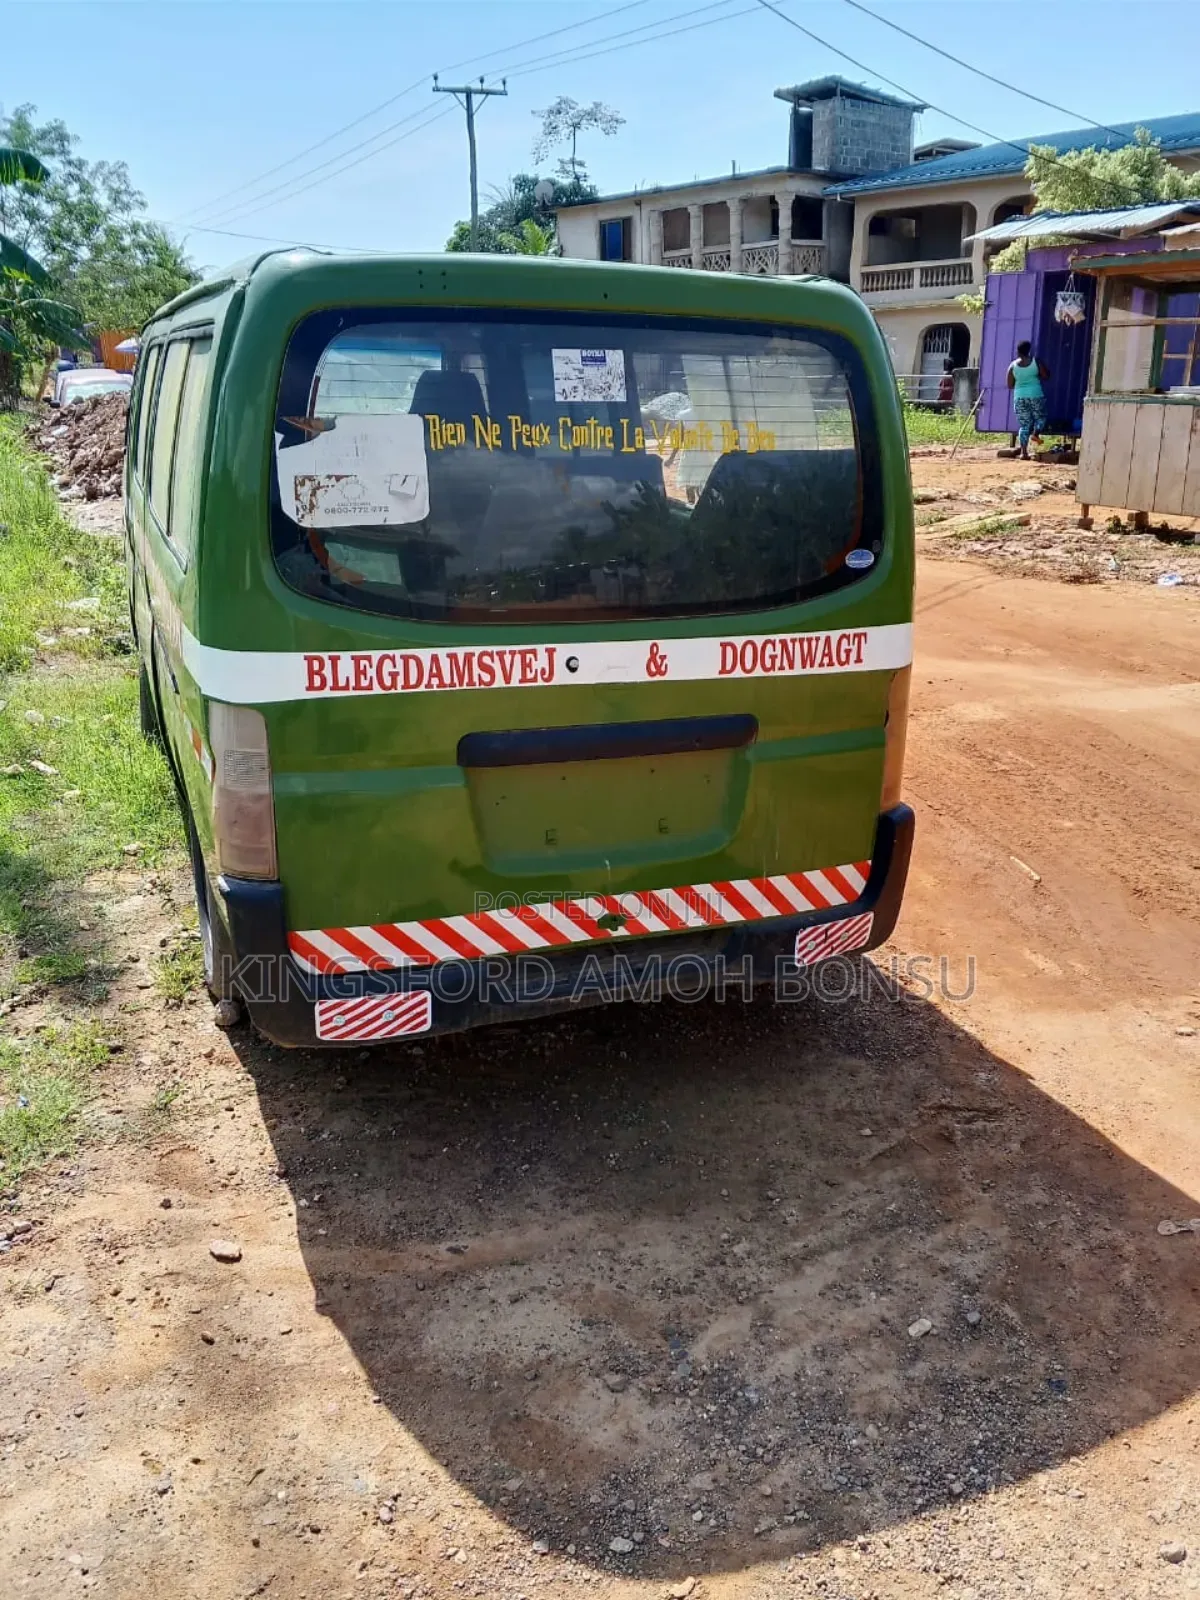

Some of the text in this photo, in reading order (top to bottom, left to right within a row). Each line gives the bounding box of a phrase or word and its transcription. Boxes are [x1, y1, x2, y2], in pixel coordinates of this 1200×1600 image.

[425, 414, 466, 450] Rien
[472, 414, 502, 451] Ne
[559, 416, 615, 450] Contre
[620, 418, 645, 452] La
[304, 632, 867, 692] BLEGDAMSVEJ & DOGNWAGT
